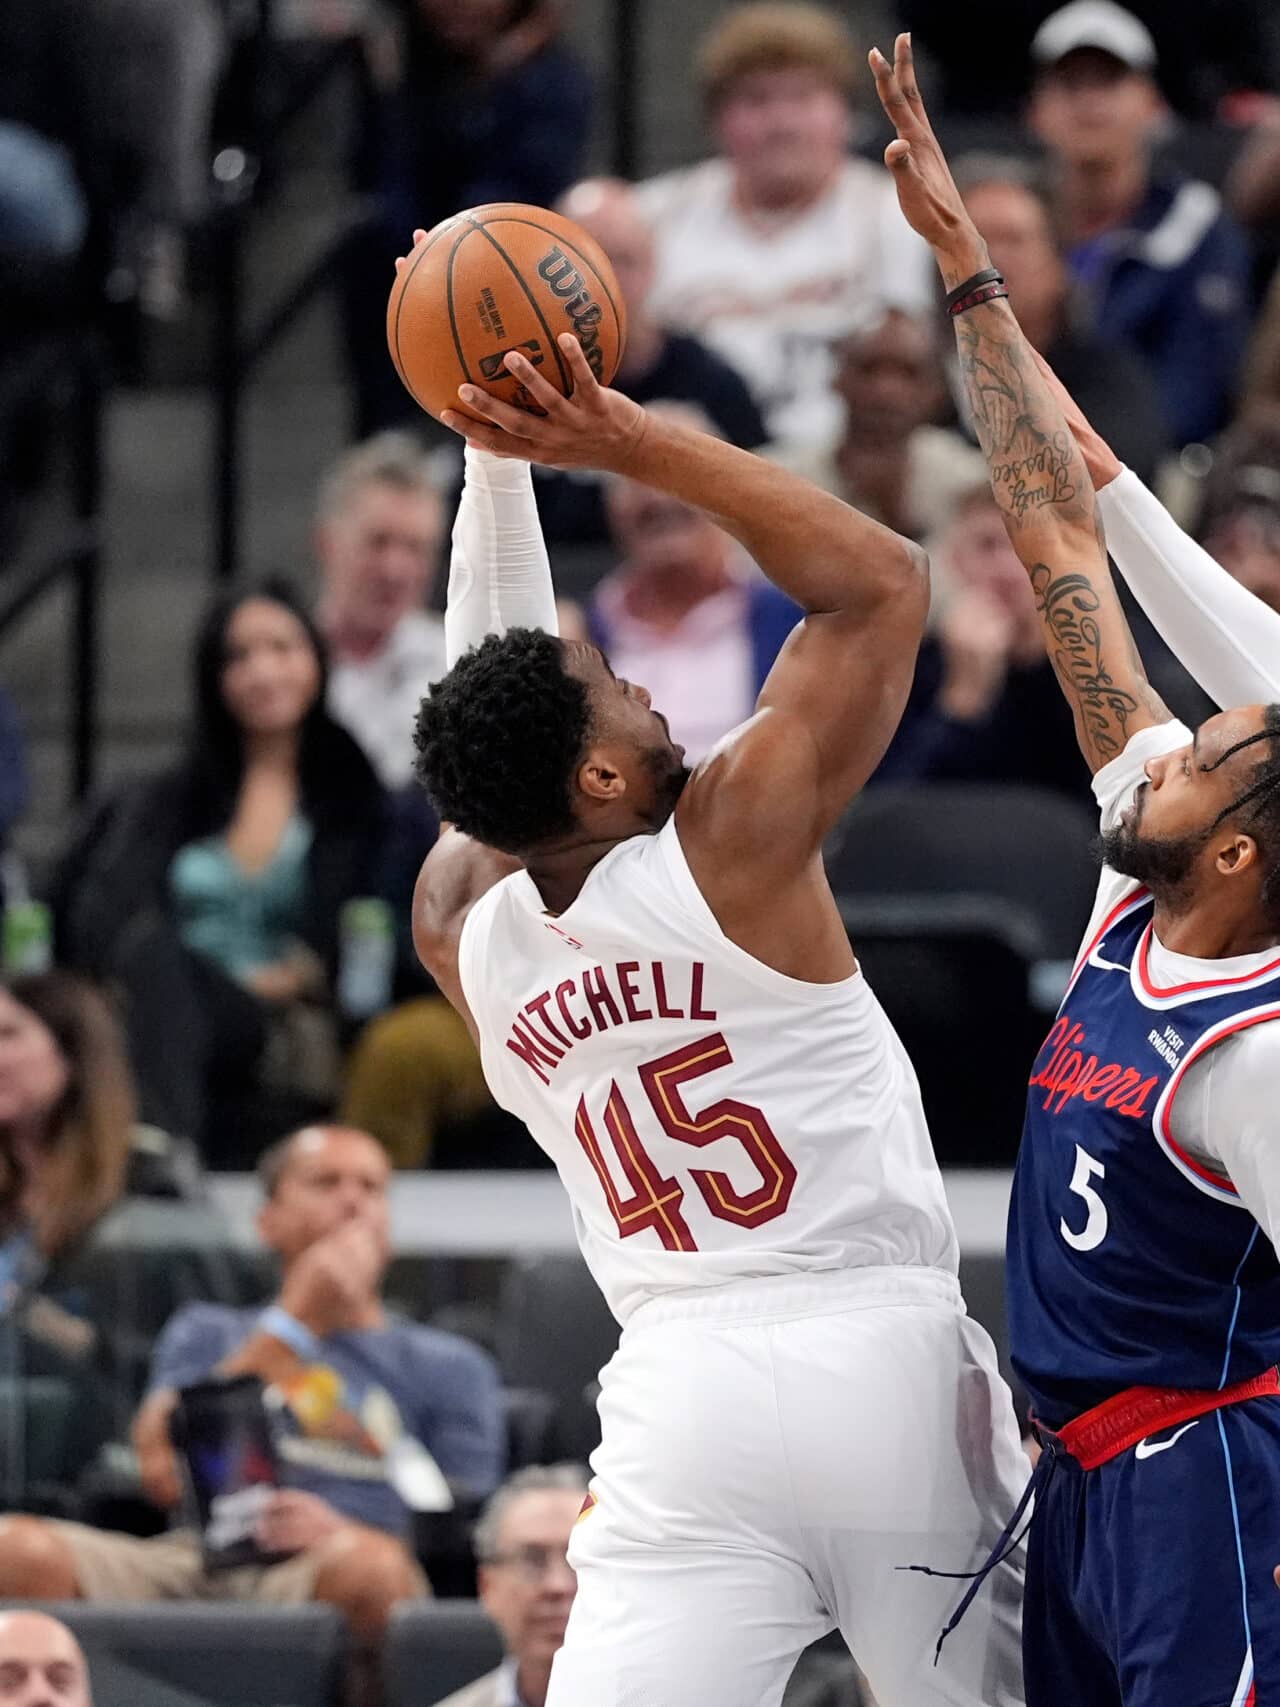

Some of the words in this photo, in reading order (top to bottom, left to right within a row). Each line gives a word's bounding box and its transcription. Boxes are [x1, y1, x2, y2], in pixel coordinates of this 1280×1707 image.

[506, 961, 717, 1087] MITCHELL
[1028, 1016, 1158, 1118] Clippers
[1147, 1029, 1180, 1070] RWANDA
[1163, 1025, 1184, 1052] VISIT
[574, 1031, 798, 1252] 45
[1060, 1143, 1108, 1252] 5
